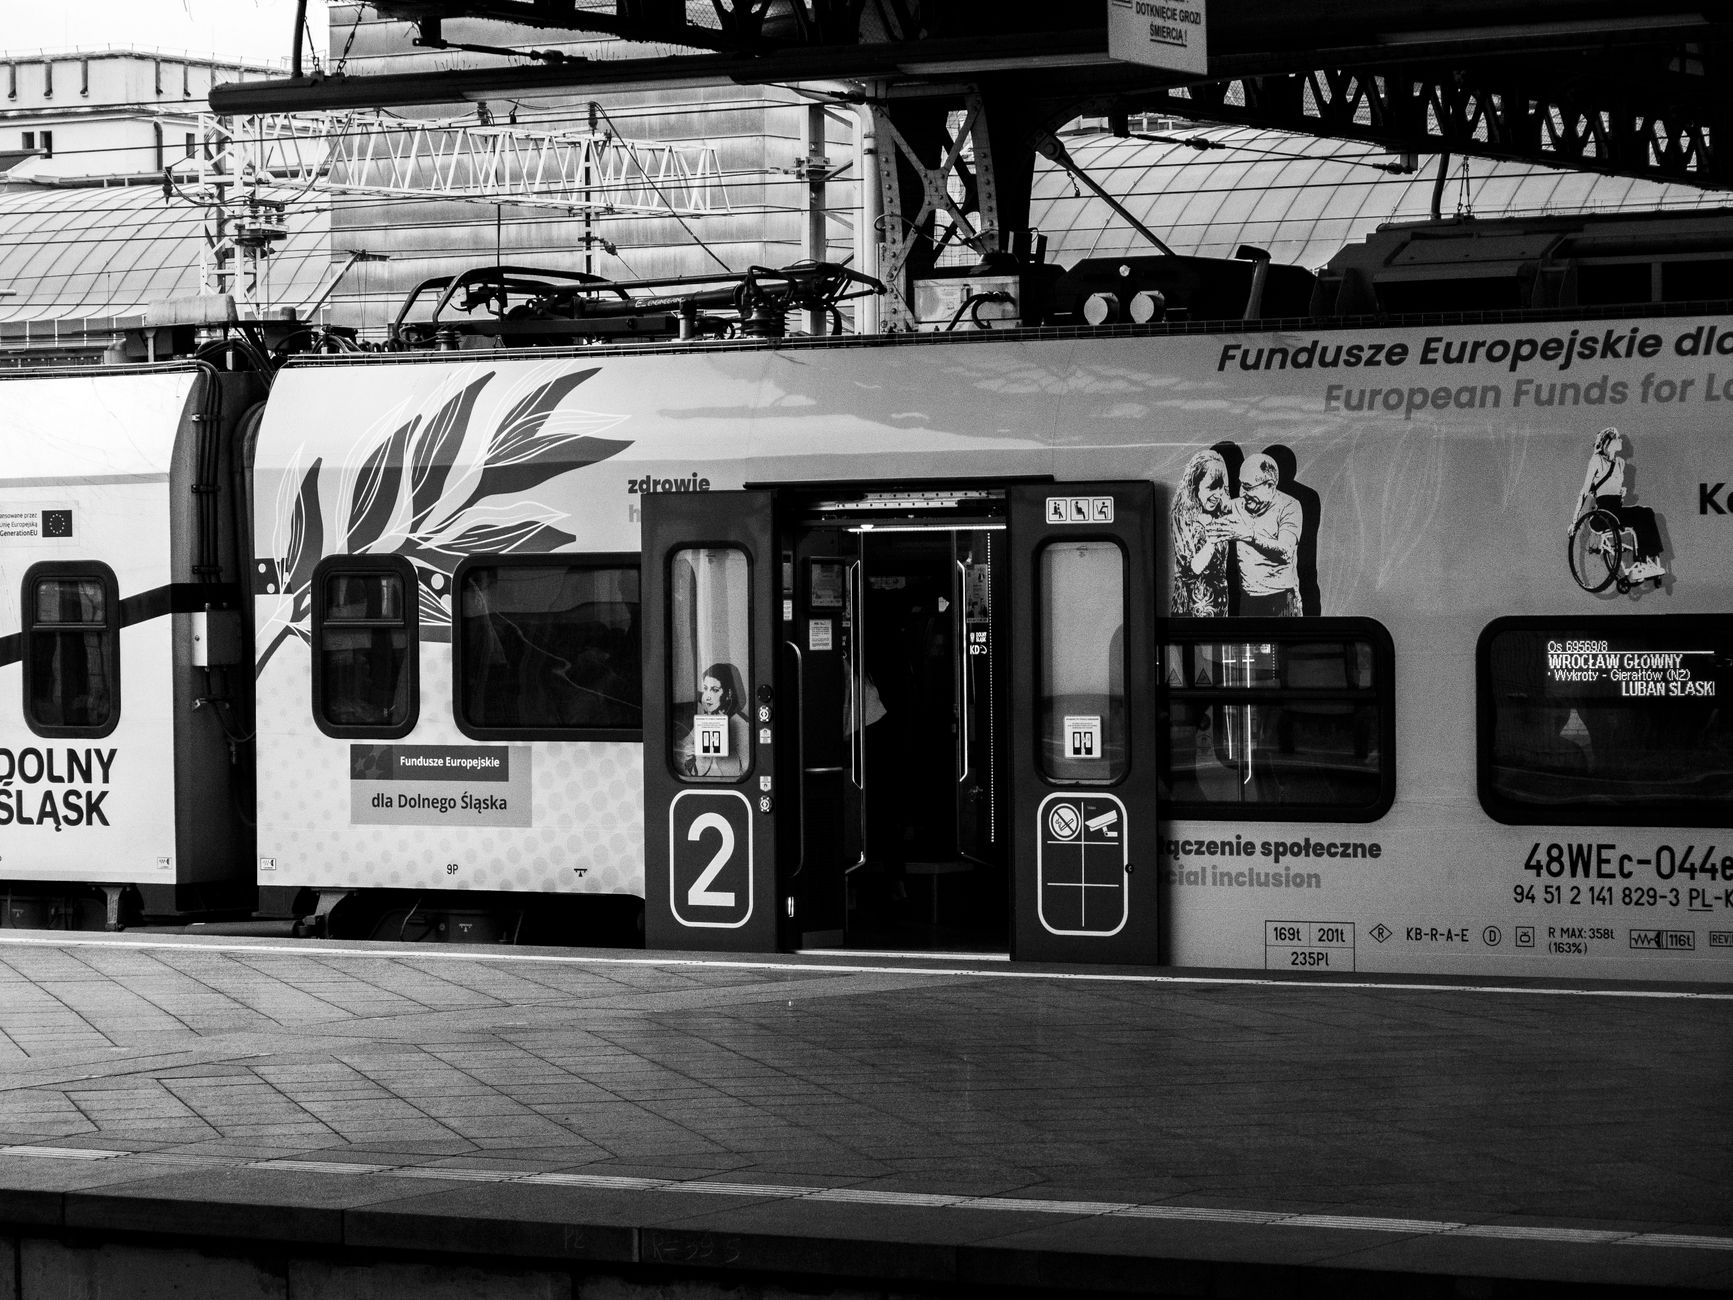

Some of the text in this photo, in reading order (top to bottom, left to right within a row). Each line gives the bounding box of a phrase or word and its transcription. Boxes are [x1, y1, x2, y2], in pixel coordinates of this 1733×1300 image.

[1136, 1, 1201, 25] DOTKNIĘCIE GROZI
[1217, 339, 1409, 371] Fundusze
[1419, 327, 1662, 372] Europejskie
[1324, 380, 1501, 420] European
[1513, 375, 1629, 407] Funds
[1641, 372, 1694, 404] for
[628, 472, 710, 494] zdrowie
[1566, 641, 1608, 652] 69569/8
[1548, 654, 1620, 669] WROCŁAW
[1554, 669, 1599, 681] Wykroty
[1610, 669, 1663, 681] Gierałtów
[0, 747, 118, 784] DOLNY
[400, 756, 500, 770] Fundusze Europejskie
[0, 781, 111, 832] ŚLĄSK
[371, 791, 507, 814] dla Dolnego Śląska
[688, 813, 735, 906] 2
[1260, 837, 1382, 863] społeczne
[1211, 864, 1321, 888] inclusion
[1513, 885, 1536, 904] 94
[1543, 885, 1561, 904] 51
[1570, 886, 1581, 905] 2
[1589, 886, 1613, 906] 141
[1621, 887, 1680, 906] 829-3
[1273, 927, 1346, 943] 169t 201t
[1406, 928, 1469, 942] KB-R-A-E
[1549, 927, 1555, 939] R
[1669, 934, 1692, 948] 116t
[1548, 942, 1587, 955] (163%)
